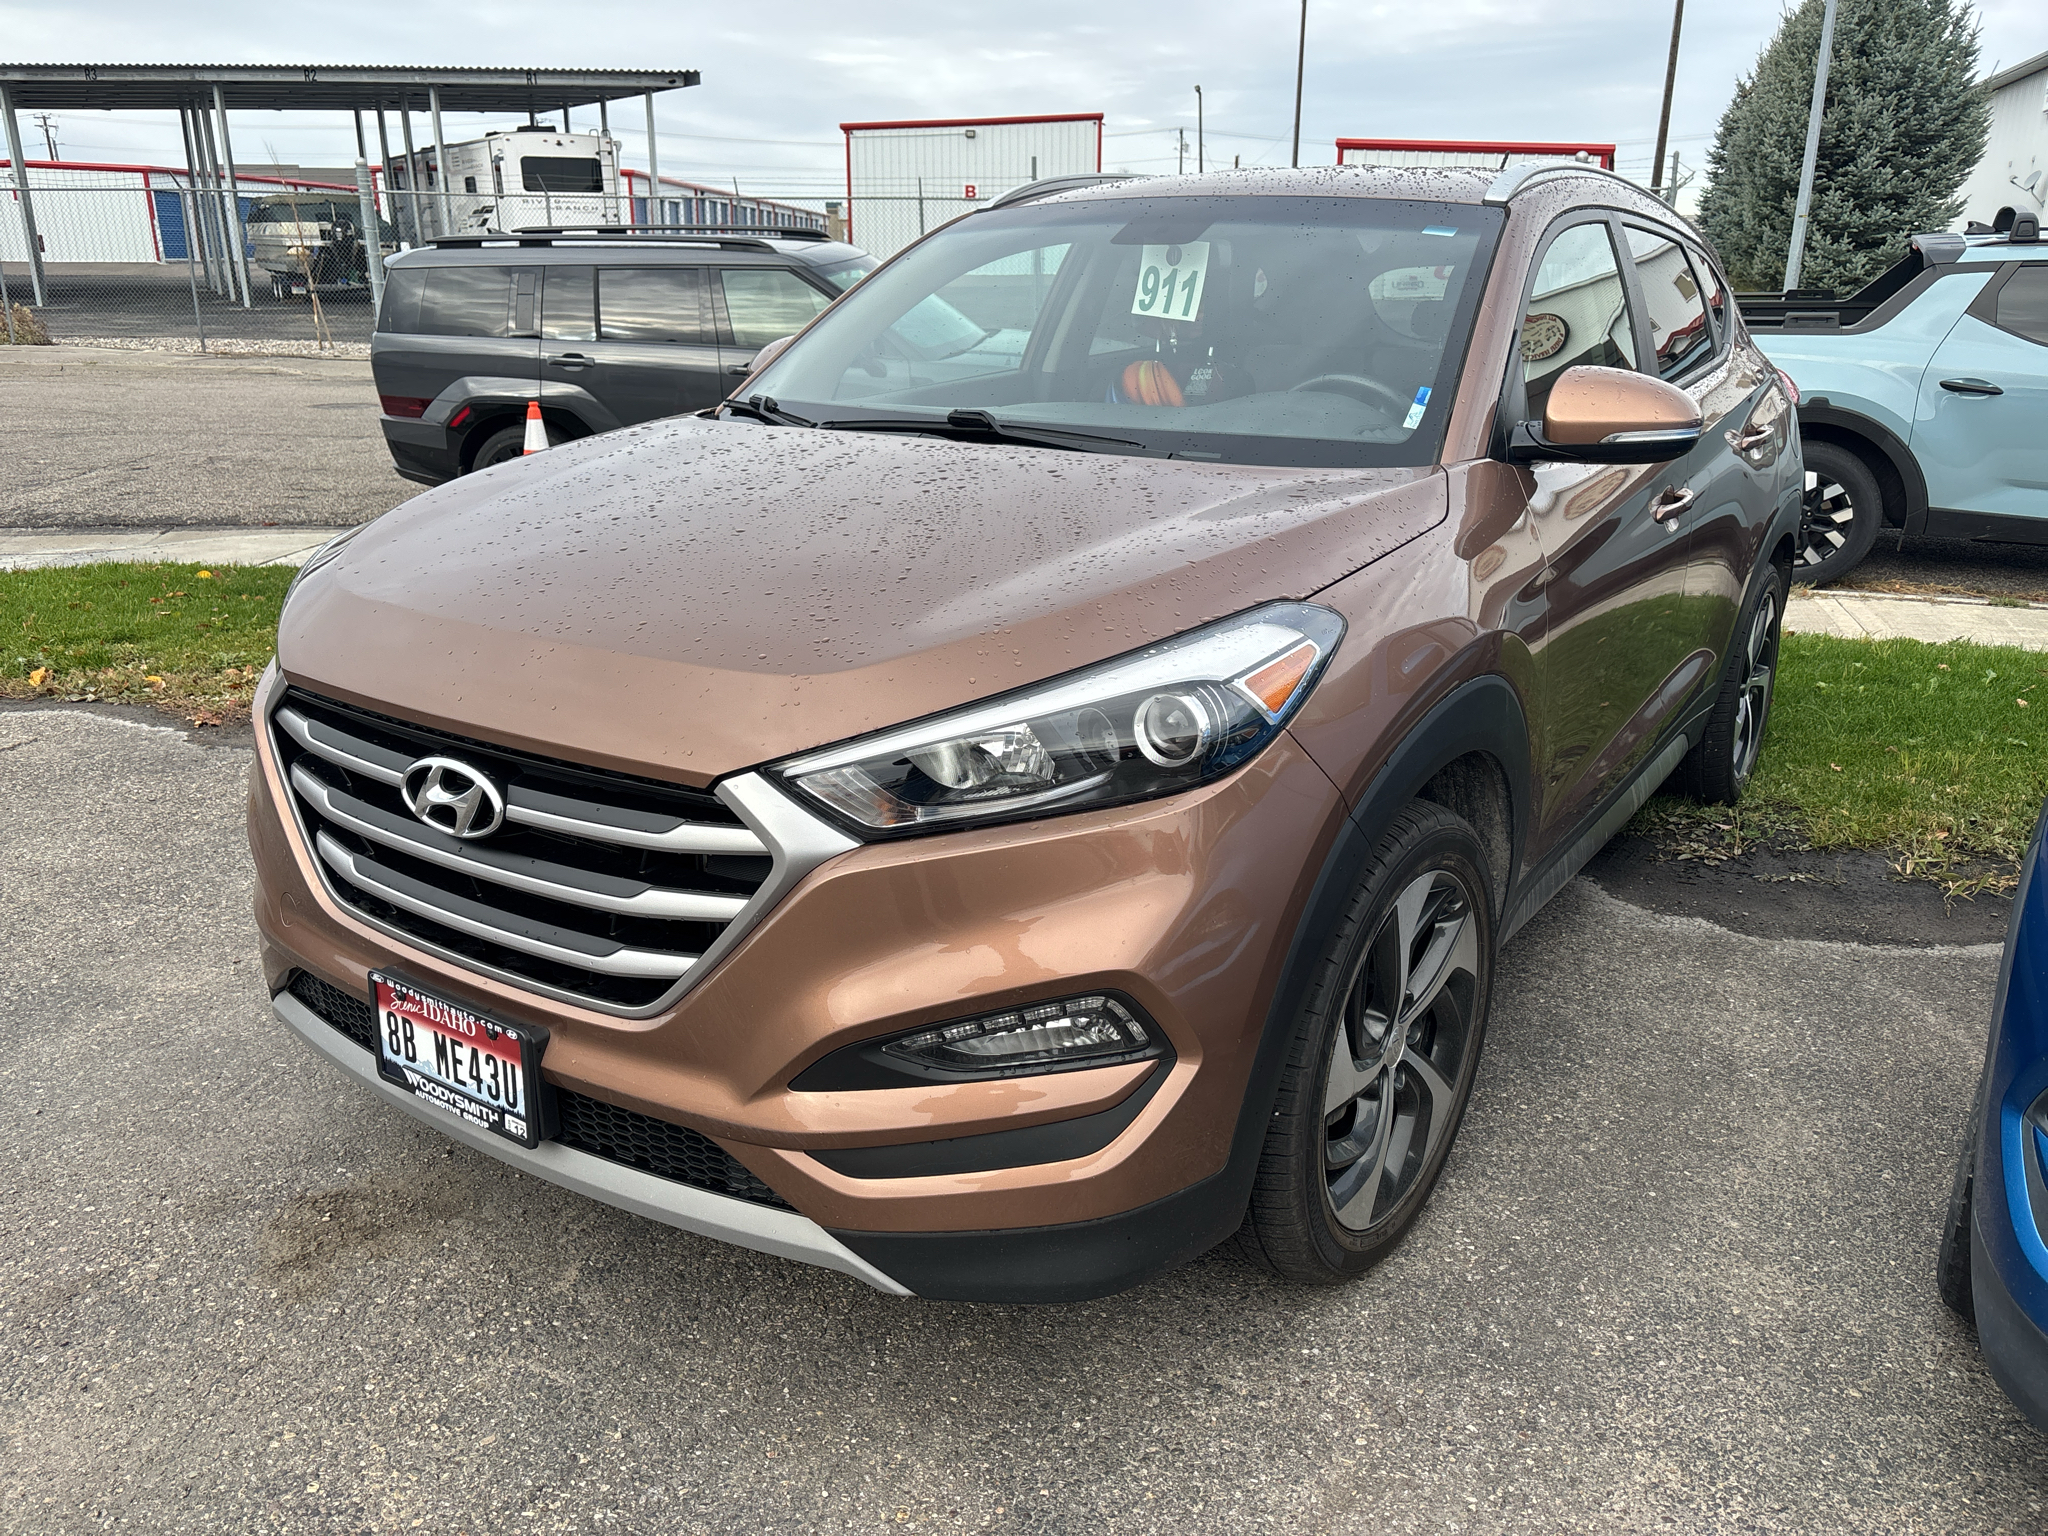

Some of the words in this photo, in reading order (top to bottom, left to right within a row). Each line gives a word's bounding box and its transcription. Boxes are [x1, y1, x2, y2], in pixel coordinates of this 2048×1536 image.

[84, 68, 97, 80] R3
[303, 69, 317, 82] R2
[526, 72, 538, 85] R1
[965, 185, 976, 198] B
[1139, 265, 1198, 316] 911
[386, 979, 502, 1034] woodysmithauto.com
[390, 992, 424, 1013] Scenic
[422, 1001, 476, 1037] IDAHO
[386, 1010, 417, 1063] 8B
[433, 1030, 517, 1109] ME43U
[402, 1068, 499, 1123] WOODYSMITH
[415, 1089, 461, 1116] AUTOMOTIVE
[462, 1111, 490, 1129] GROUP
[514, 1125, 526, 1139] 12
